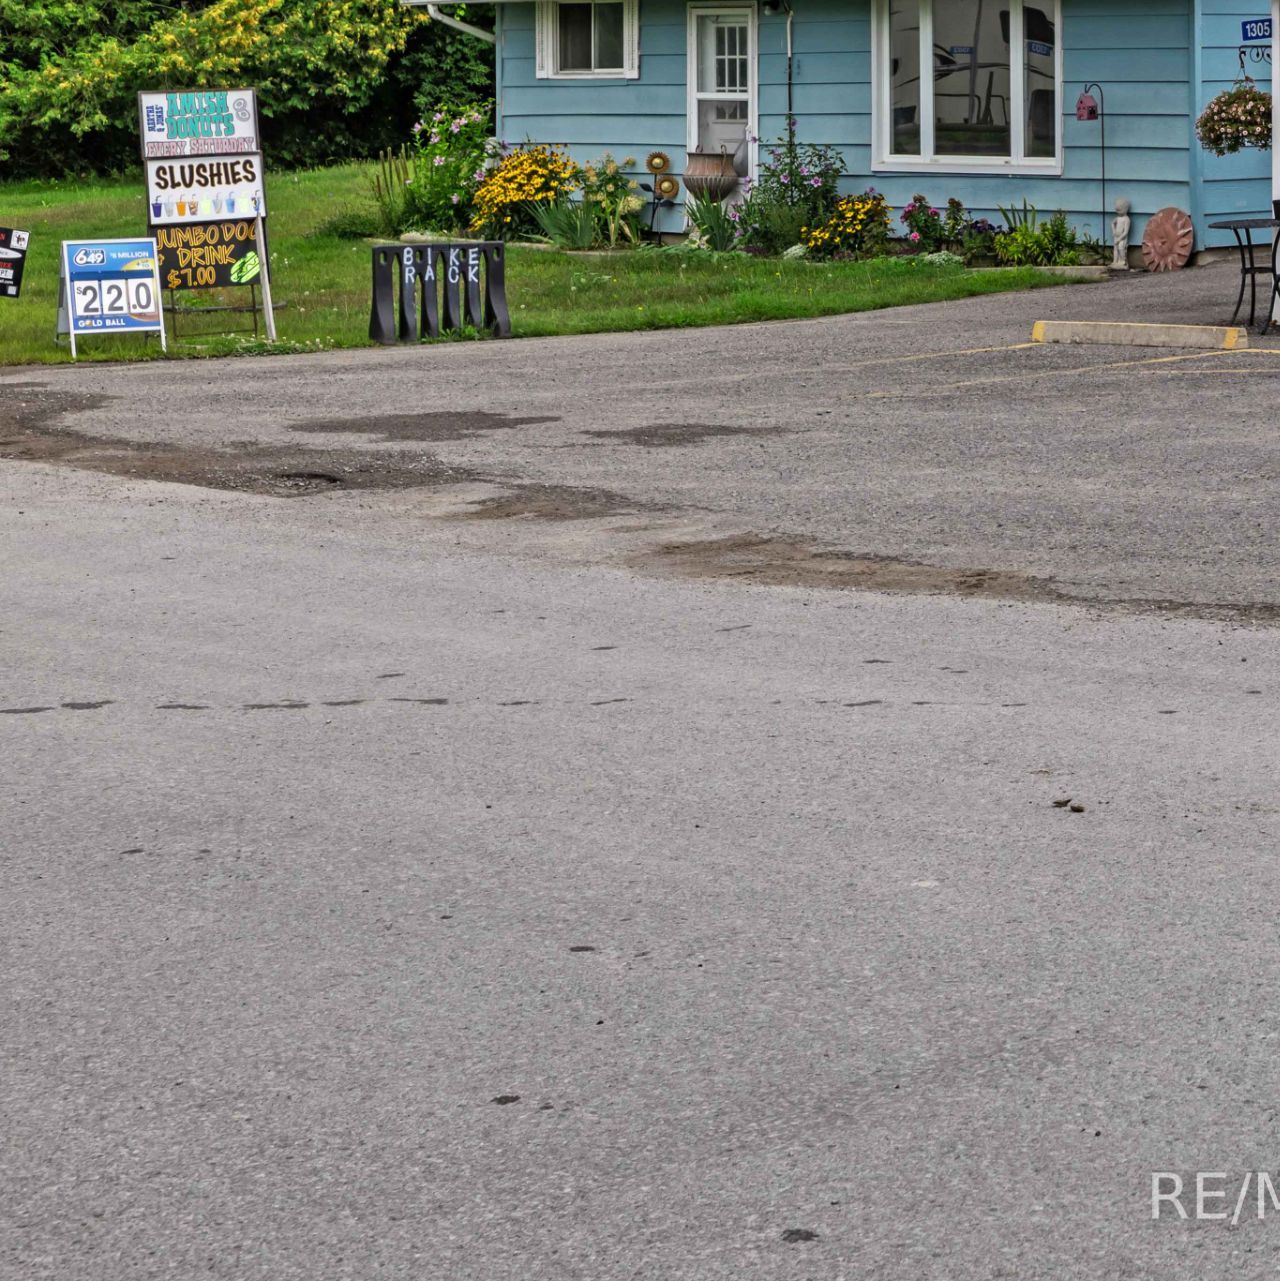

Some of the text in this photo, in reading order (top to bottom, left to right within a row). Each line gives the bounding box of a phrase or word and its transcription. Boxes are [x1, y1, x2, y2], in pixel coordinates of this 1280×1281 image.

[1245, 22, 1270, 37] 1305
[166, 91, 229, 116] AMISH
[165, 113, 235, 139] DONUTS
[146, 136, 254, 157] EVERY SATURDAY
[155, 159, 256, 190] SLUSHIES
[156, 225, 219, 250] JUMBO
[117, 251, 149, 259] MILLION
[177, 244, 236, 267] DRINK
[403, 247, 479, 265] BIKE
[168, 266, 216, 289] $7.00
[405, 265, 478, 283] RACK
